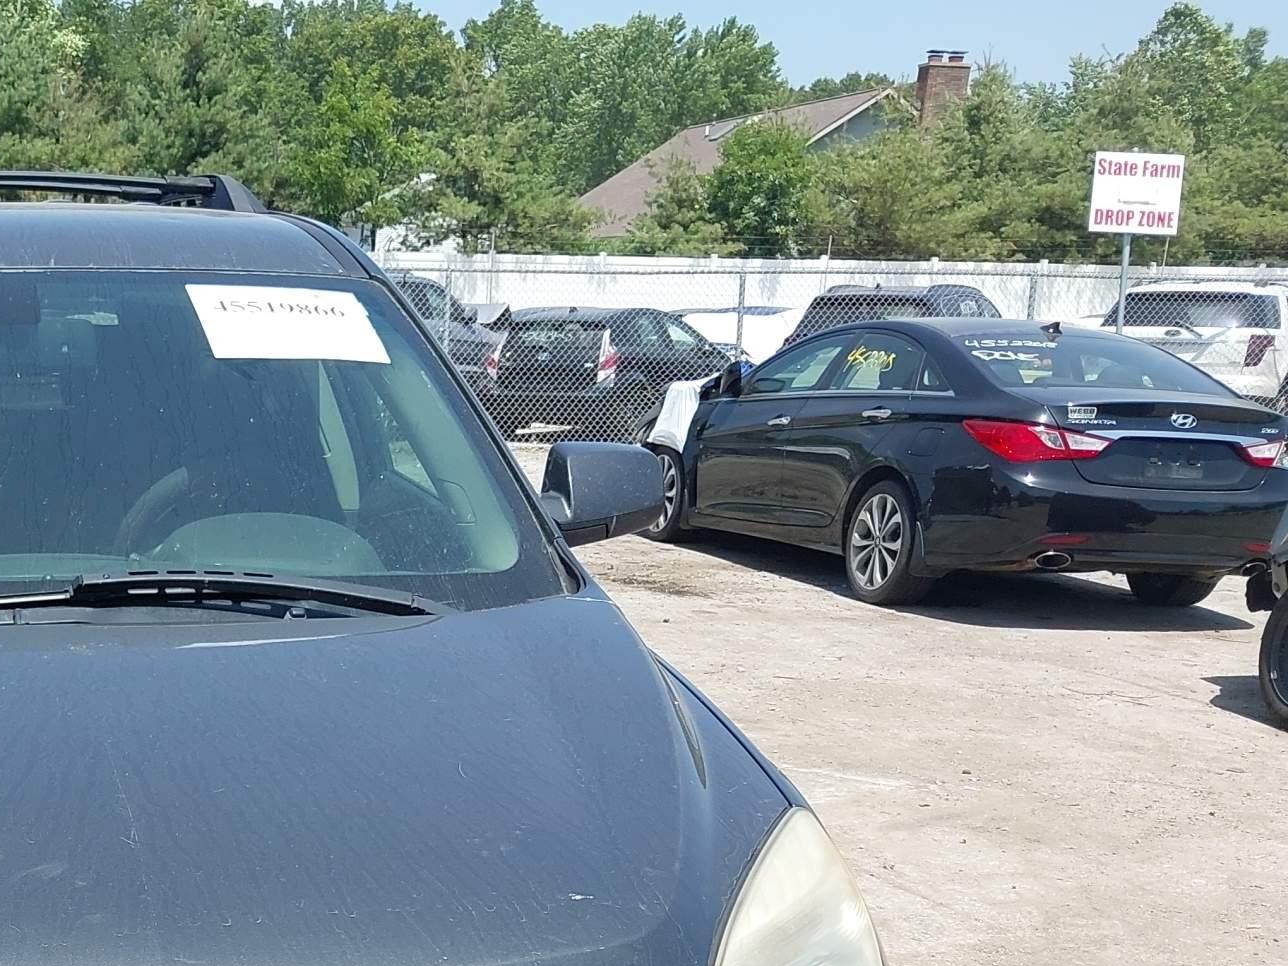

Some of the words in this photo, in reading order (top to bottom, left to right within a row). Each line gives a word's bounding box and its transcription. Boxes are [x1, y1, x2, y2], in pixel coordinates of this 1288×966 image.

[1098, 158, 1138, 177] State
[1142, 160, 1181, 178] Farm
[1094, 208, 1135, 226] DROP
[1138, 210, 1175, 229] ZONE
[214, 301, 345, 318] 45519866
